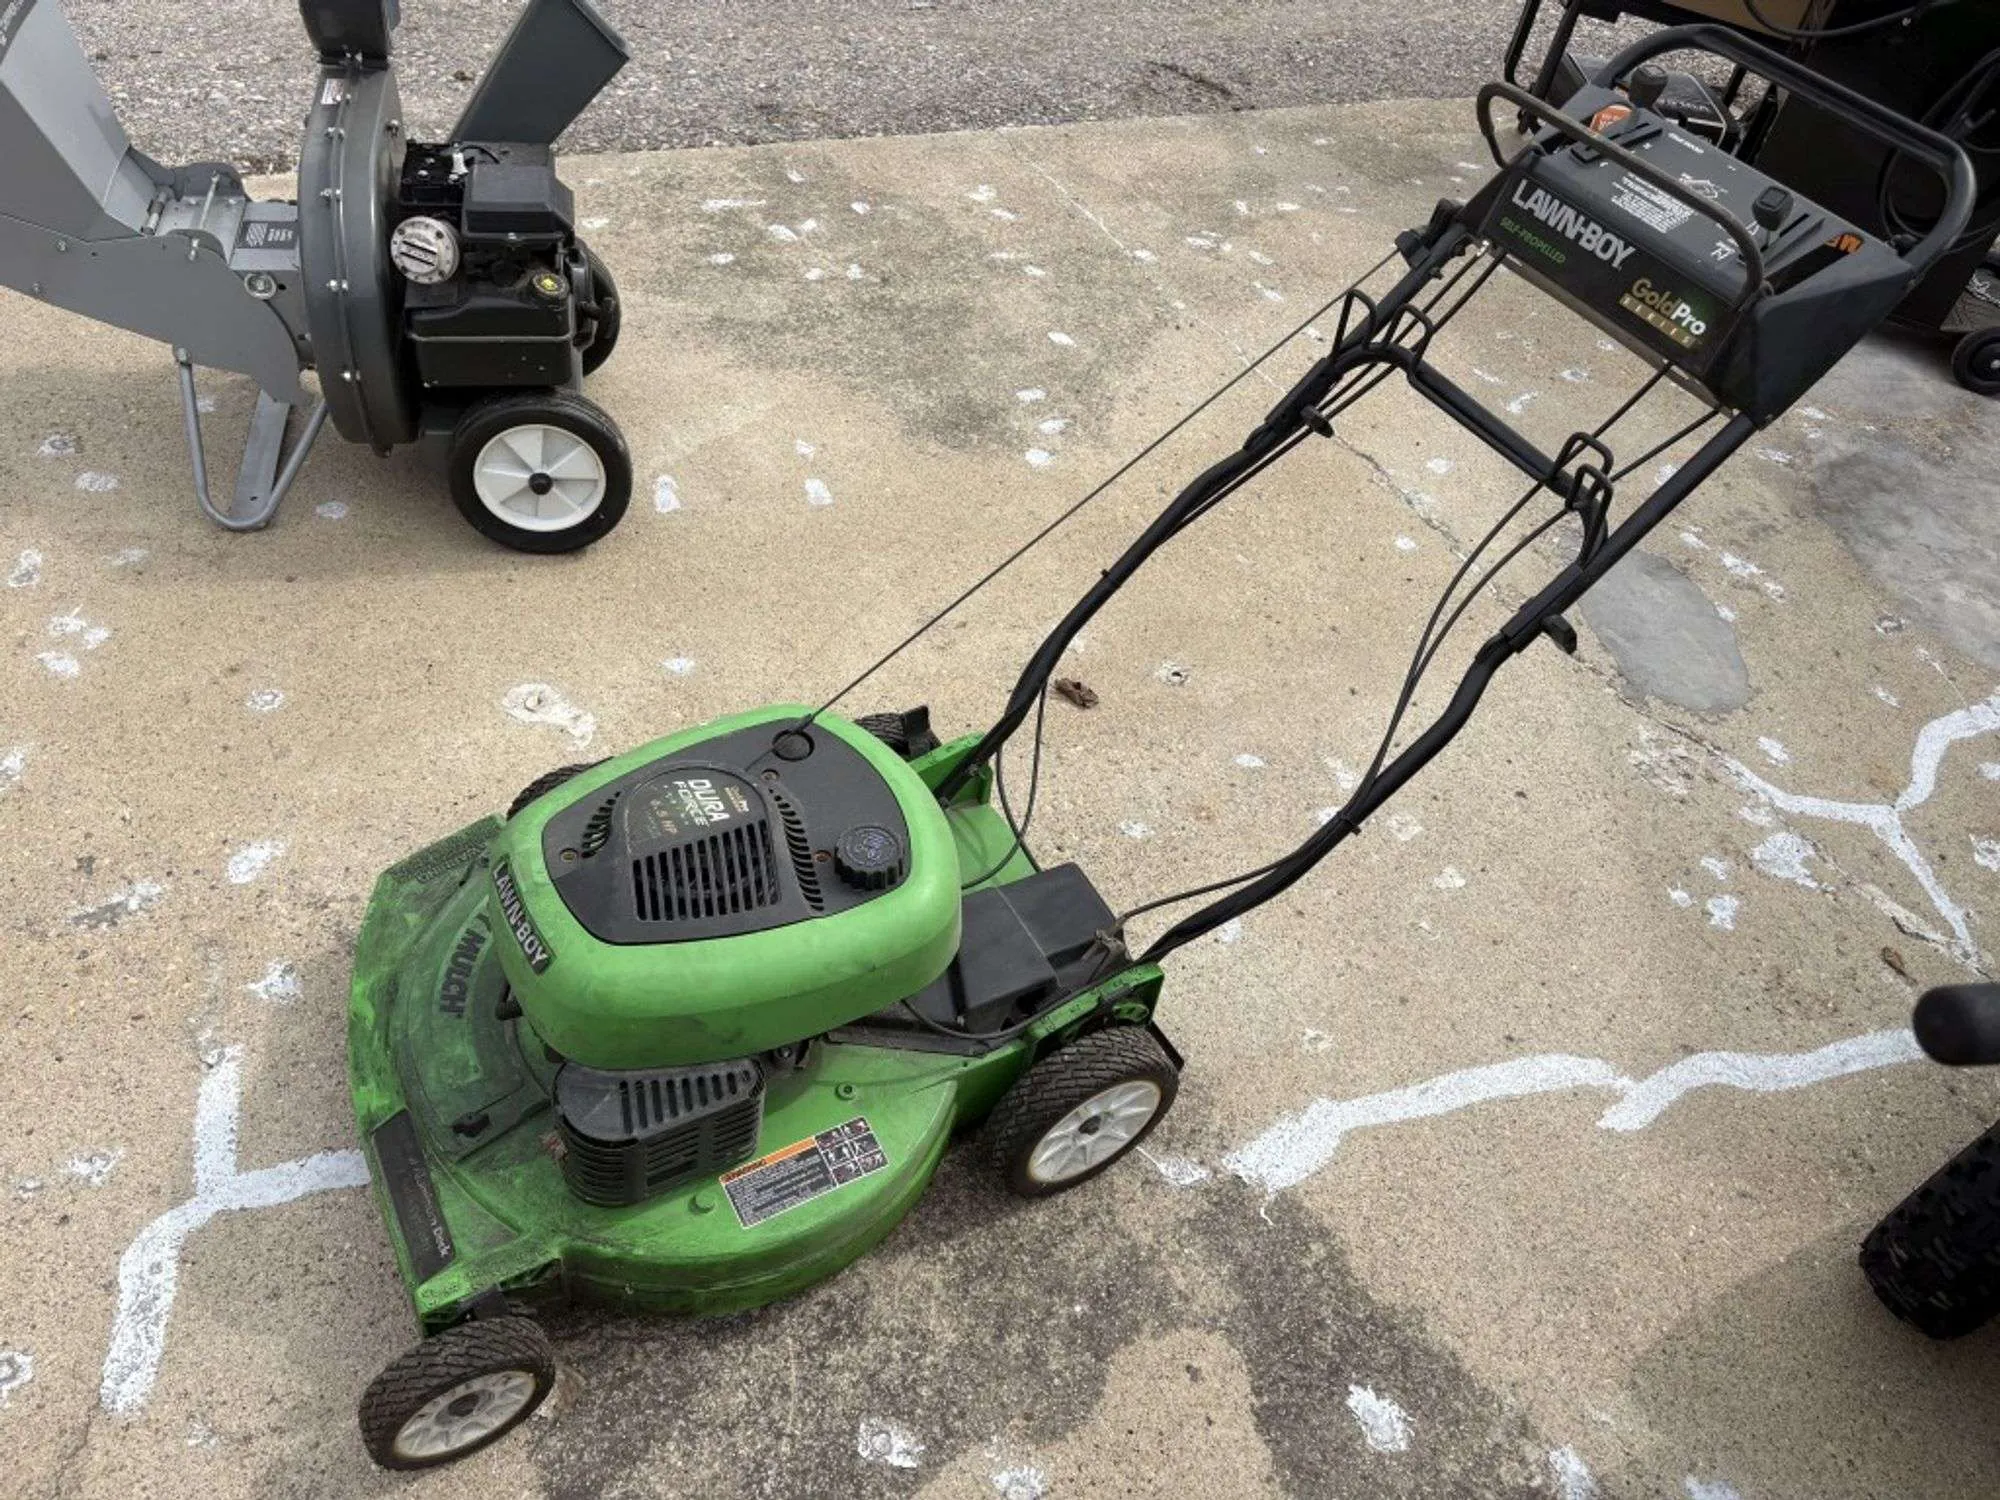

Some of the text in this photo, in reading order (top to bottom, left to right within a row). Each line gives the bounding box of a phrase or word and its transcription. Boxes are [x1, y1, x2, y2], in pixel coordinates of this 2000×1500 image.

[1511, 178, 1636, 272] LAWN-BOY
[671, 779, 709, 827] FORCE
[688, 778, 730, 823] DURA
[493, 864, 549, 967] LAWN-BOY
[438, 927, 486, 1019] MULCH
